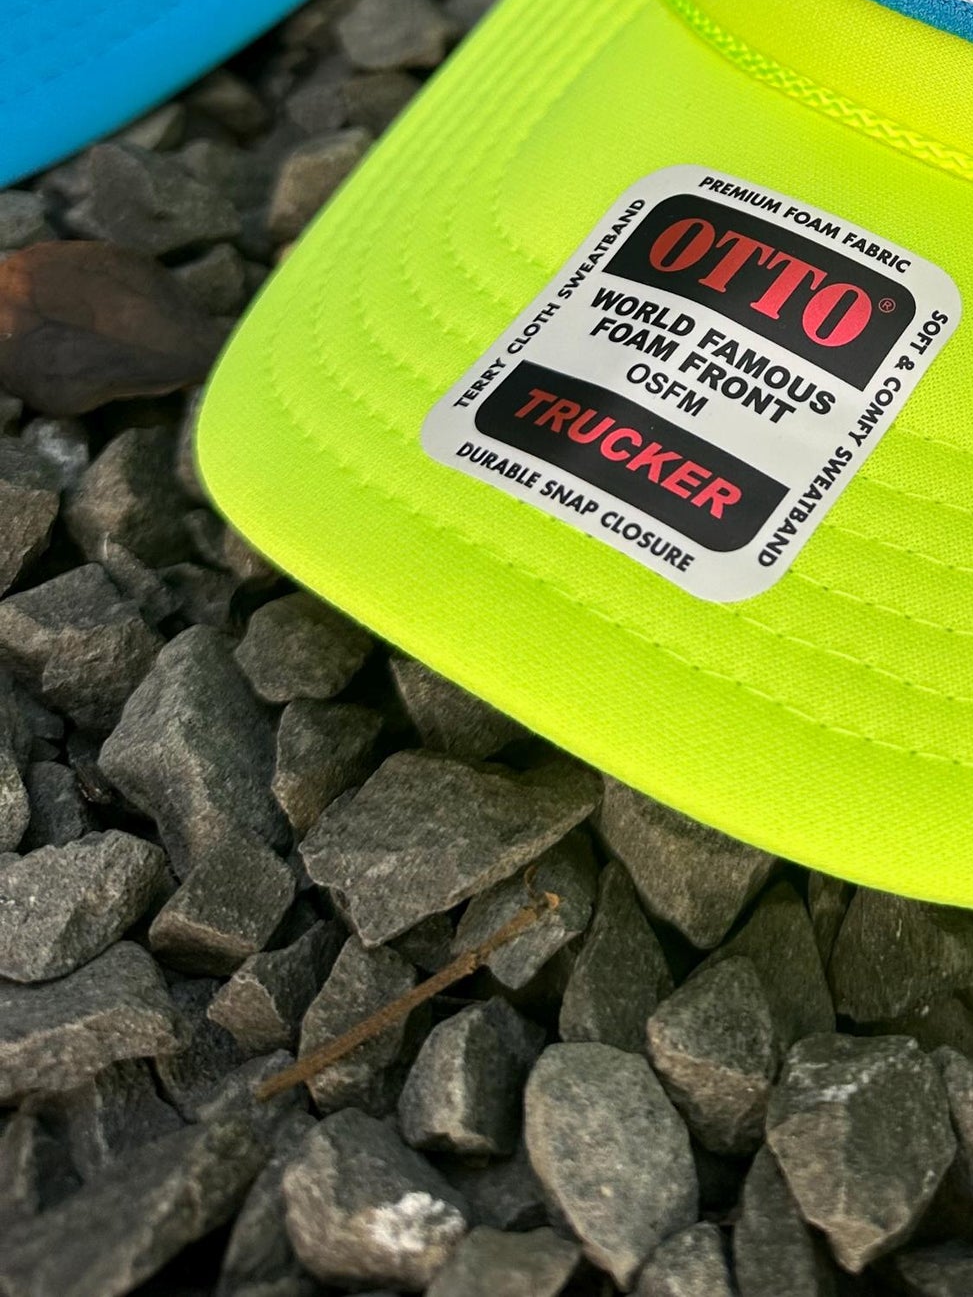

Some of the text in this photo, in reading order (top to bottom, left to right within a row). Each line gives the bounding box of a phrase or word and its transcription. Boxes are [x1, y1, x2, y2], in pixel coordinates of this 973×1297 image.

[699, 176, 911, 275] PREMIUM FOAM FABRIC
[453, 198, 646, 409] TERRY CLOTH SWEATBAND
[590, 288, 836, 415] WORLD FAMOUS
[589, 317, 797, 425] FOAM FRONT
[625, 362, 710, 418] OSFM
[513, 389, 743, 519] TRUCKER
[757, 309, 949, 568] SOFT & COMFY SWEATBAND
[455, 442, 696, 573] DURABLE SNAP CLOSURE
